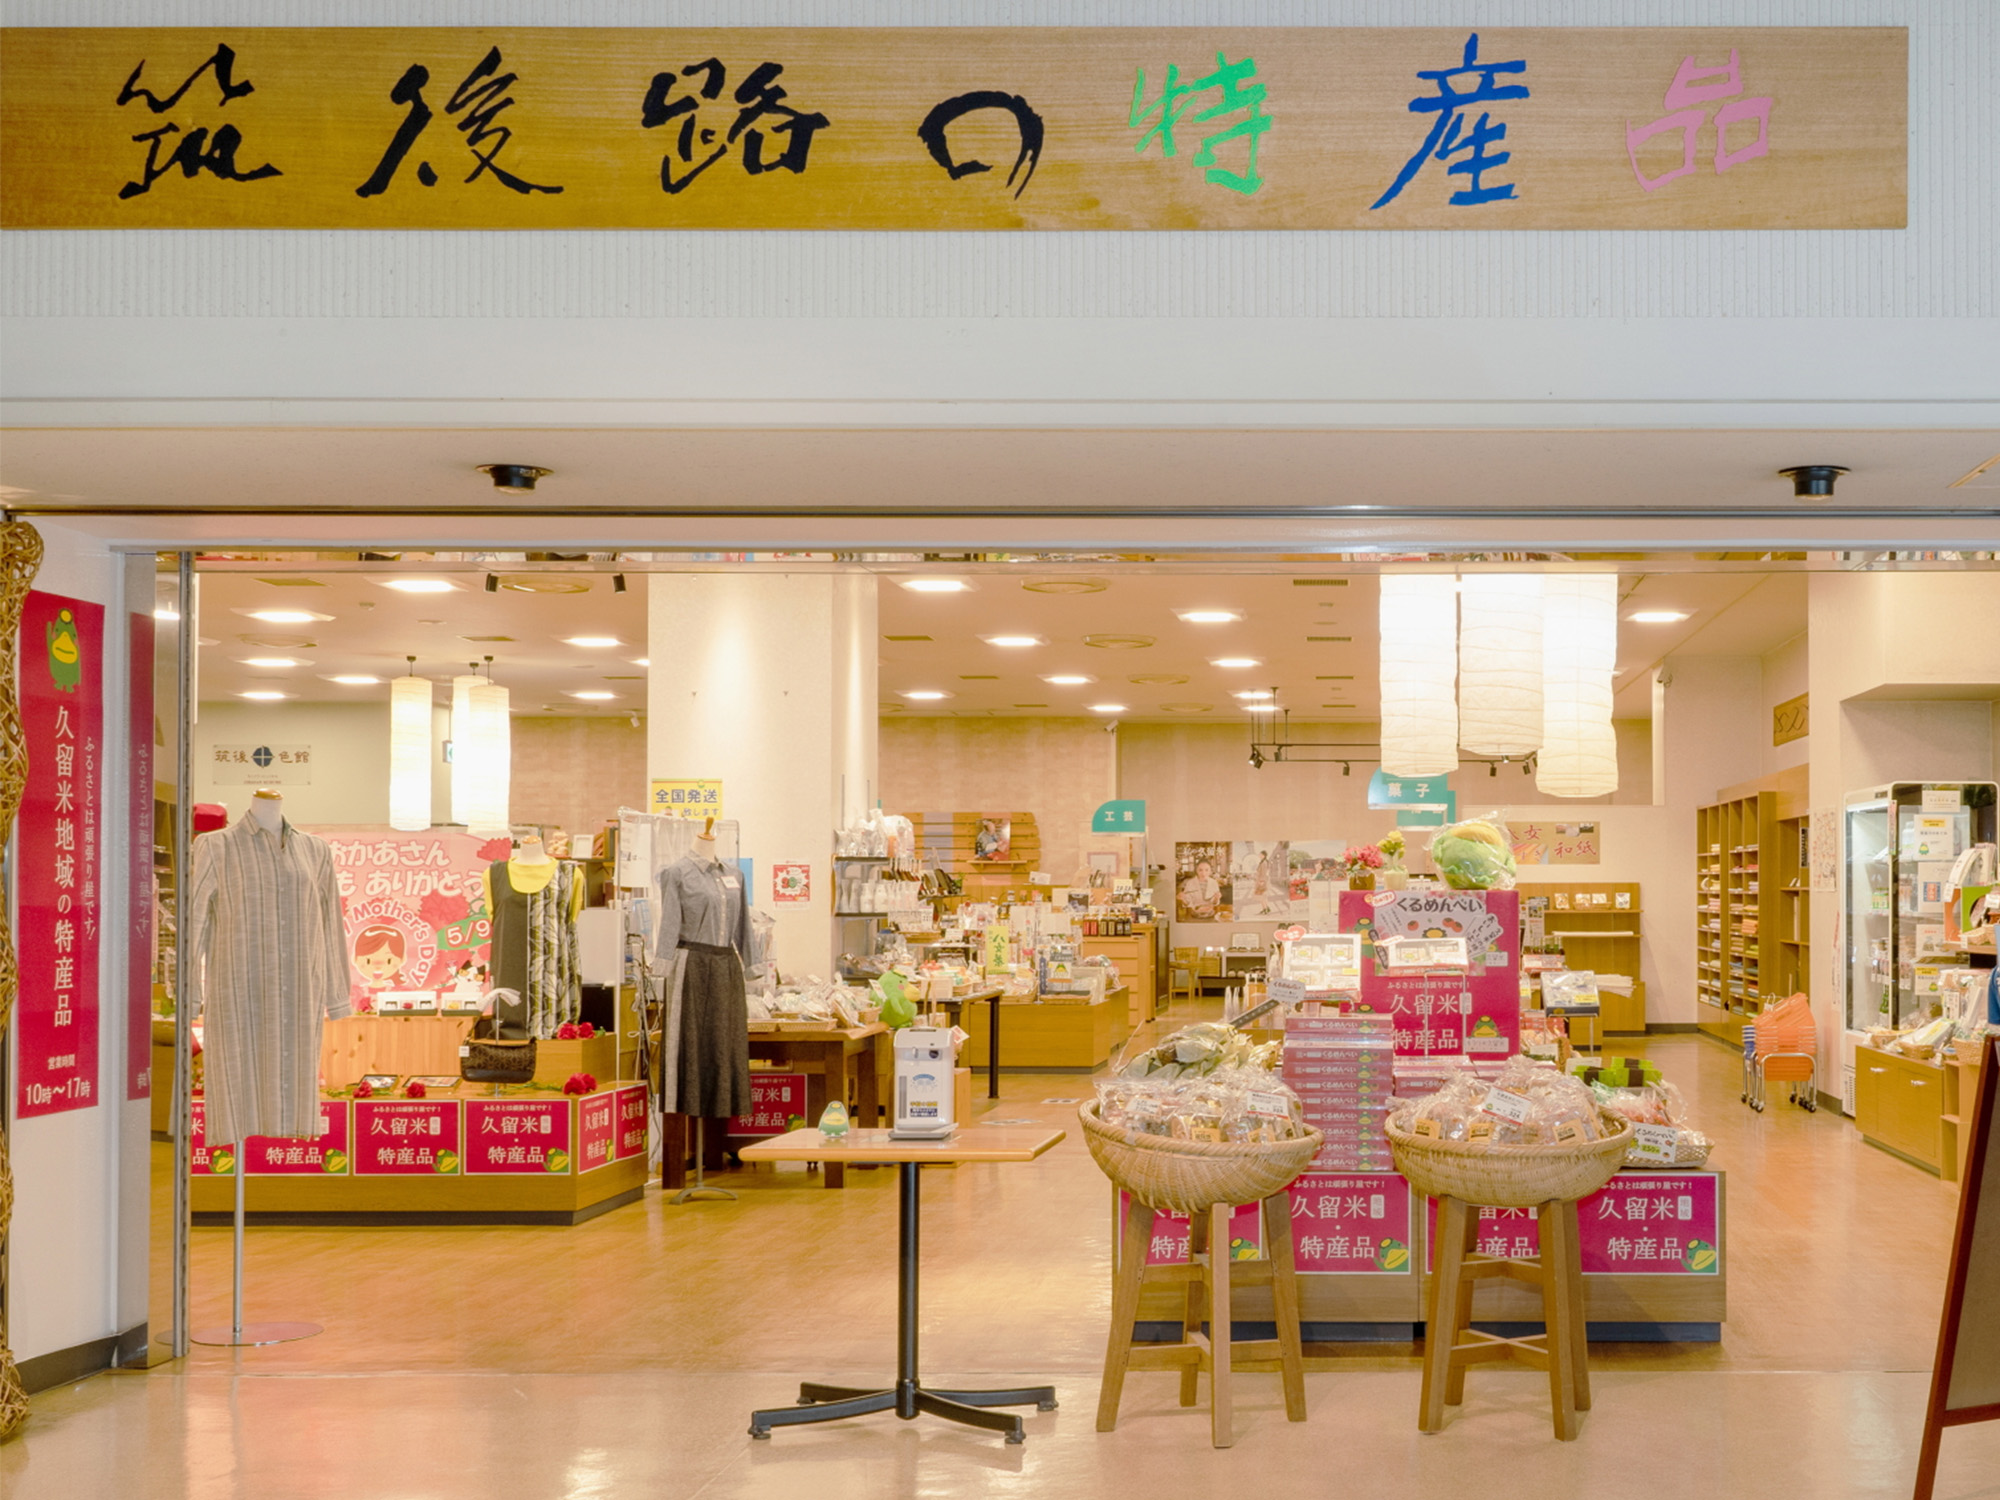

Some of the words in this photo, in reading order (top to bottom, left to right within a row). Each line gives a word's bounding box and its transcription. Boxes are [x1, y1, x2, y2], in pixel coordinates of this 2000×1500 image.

[115, 32, 1774, 211] 筑後路の特産品
[215, 749, 248, 764] 筑後
[655, 788, 718, 804] 全国発送
[1387, 782, 1430, 798] 菓子
[1103, 810, 1134, 823] 工芸
[329, 841, 450, 867] おかあさん
[1554, 840, 1597, 859] 和紙
[54, 705, 75, 1027] 久留米地域の特産品
[365, 870, 484, 897] ありがとう
[1396, 897, 1483, 914] くるめんべい
[353, 900, 430, 941] Mother's
[410, 943, 436, 987] Day
[447, 919, 491, 946] 5/9
[1389, 992, 1459, 1016] 久留米
[1391, 1028, 1459, 1050] 特産品
[370, 1117, 428, 1136] 久留米
[481, 1115, 539, 1135] 久留米
[265, 1146, 322, 1165] 特産品
[376, 1146, 434, 1166] 特産品
[487, 1145, 545, 1165] 特産品
[1291, 1194, 1367, 1220] 久留米
[1598, 1195, 1675, 1221] 久留米
[1299, 1235, 1376, 1260] 特産品
[1606, 1236, 1683, 1261] 特産品
